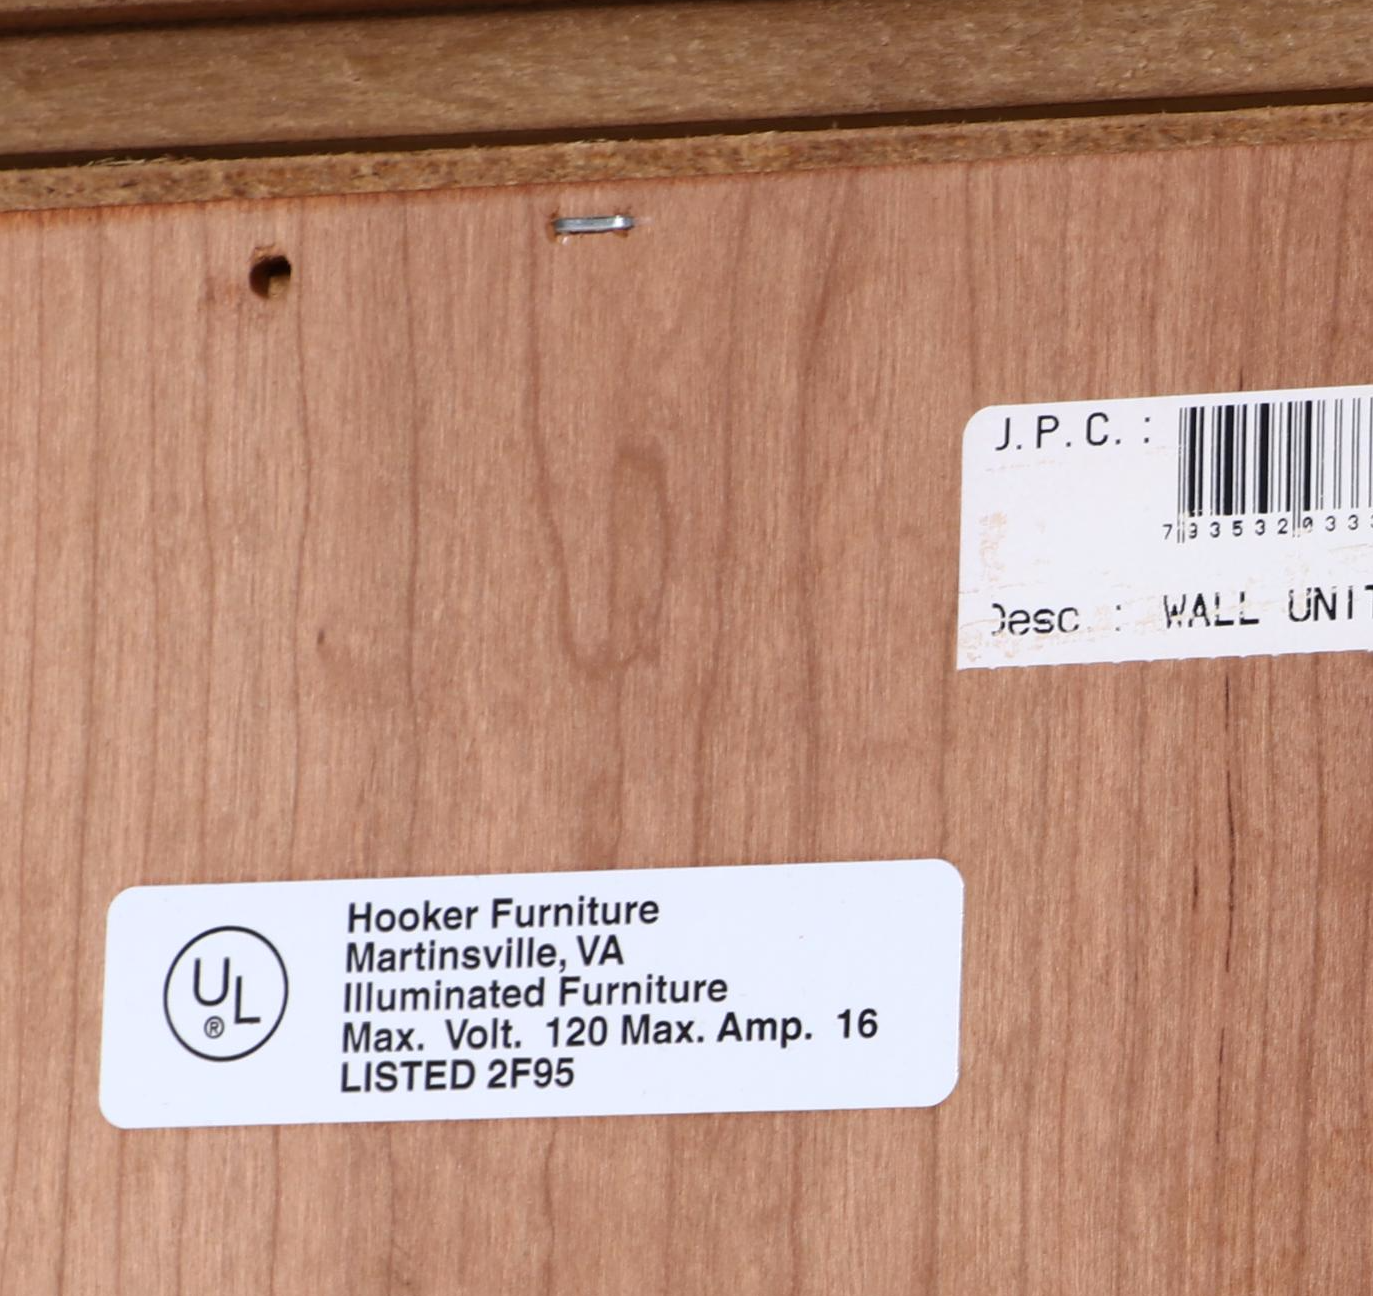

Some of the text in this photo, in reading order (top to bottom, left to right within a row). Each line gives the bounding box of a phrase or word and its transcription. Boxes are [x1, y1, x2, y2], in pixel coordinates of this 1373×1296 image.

[1164, 592, 1259, 628] WALL
[349, 896, 659, 933] Hooker Furniture
[347, 935, 623, 972] Martinsville, VA
[345, 974, 727, 1012] Illuminated Furniture
[343, 1009, 877, 1052] Max. Volt. 120 Max. Amp. 16
[341, 1058, 574, 1092] LISTED 2F95
